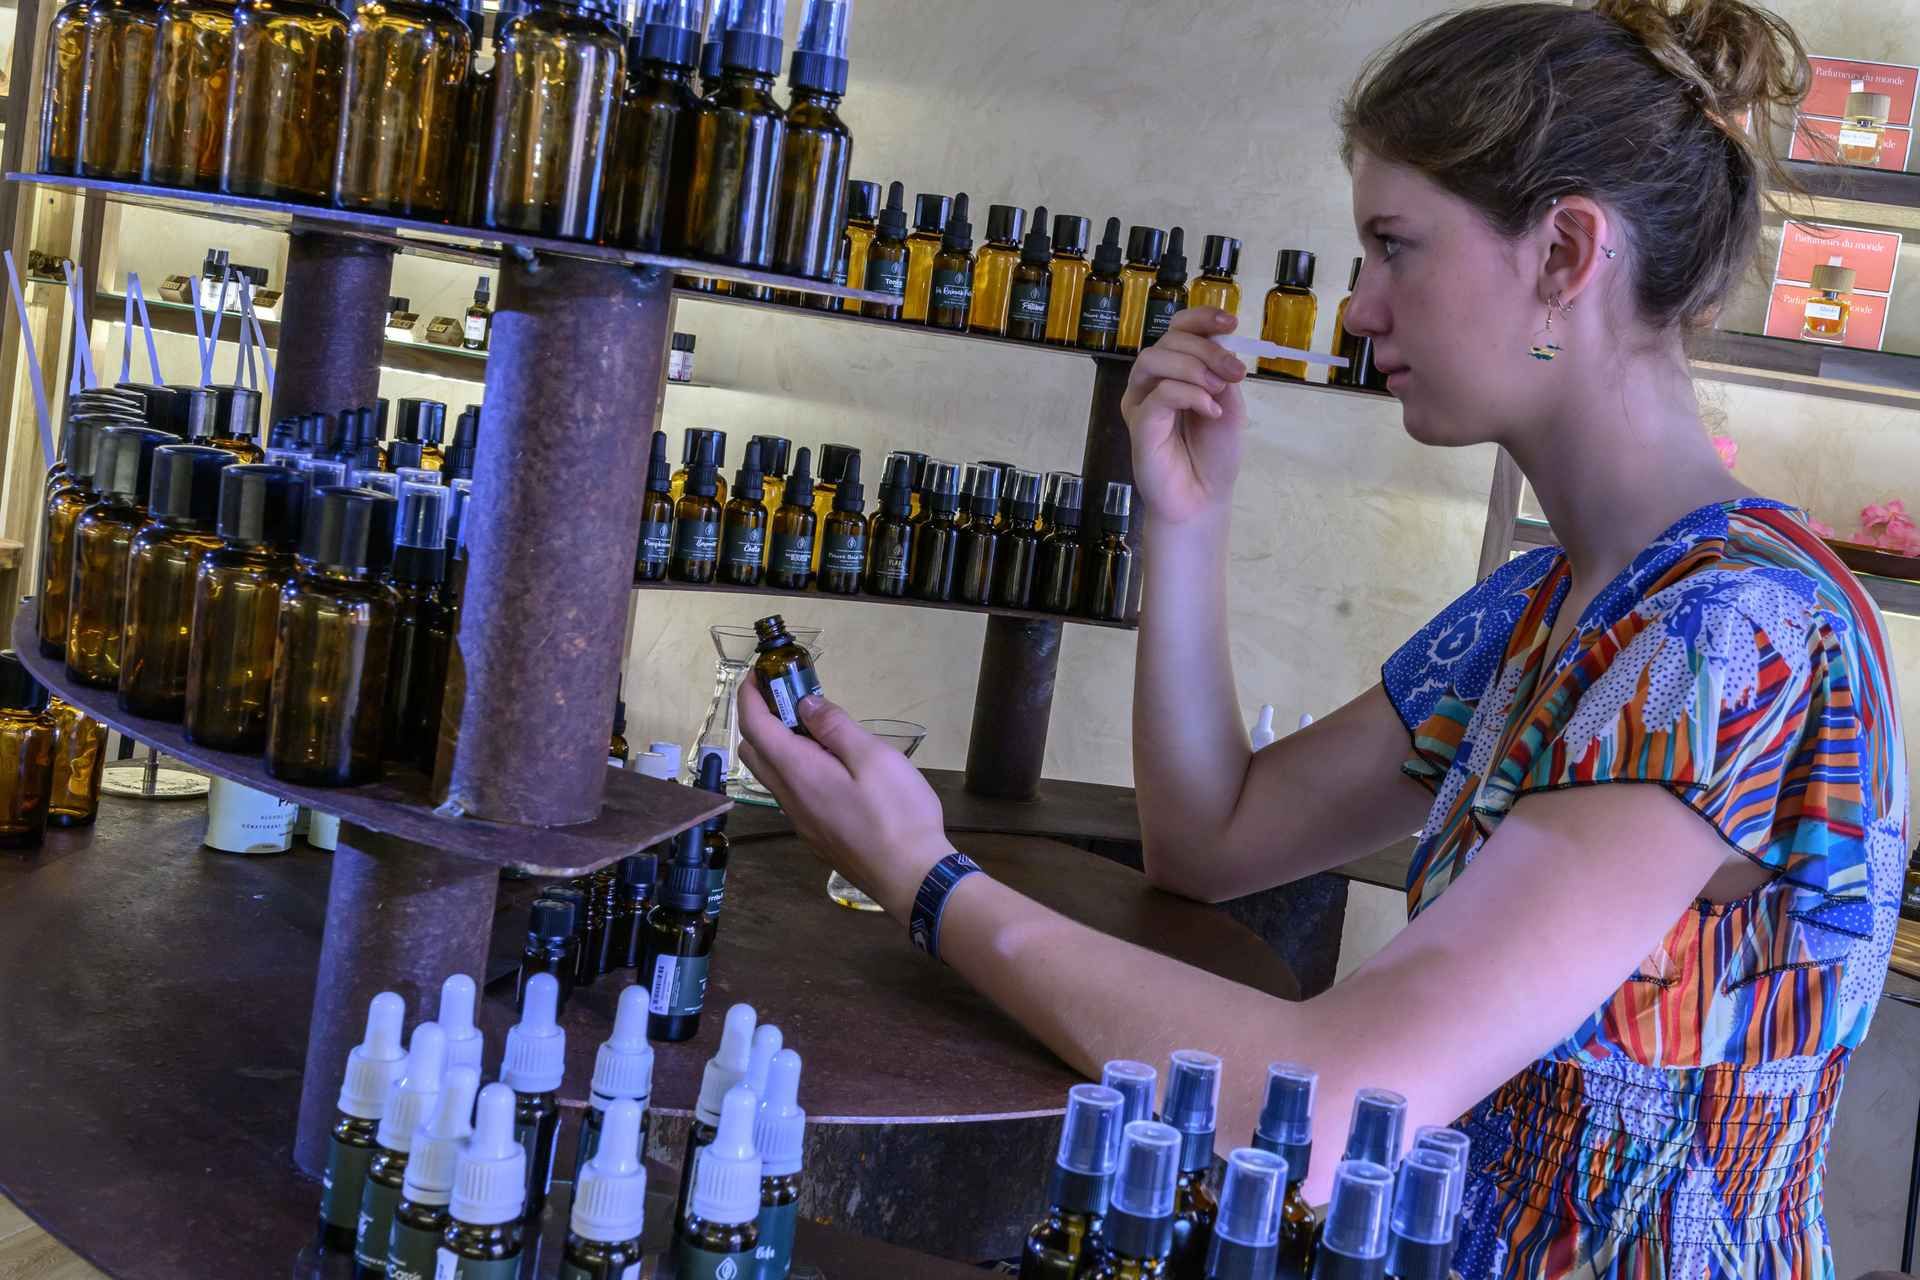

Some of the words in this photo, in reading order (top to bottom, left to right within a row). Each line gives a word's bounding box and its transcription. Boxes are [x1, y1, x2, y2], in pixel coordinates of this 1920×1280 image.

[1815, 66, 1860, 80] Parfumeurs
[1862, 71, 1874, 81] du
[1875, 74, 1905, 86] monde
[1794, 233, 1840, 247] Parfumeurs
[1841, 238, 1853, 249] du
[1855, 241, 1885, 253] monde
